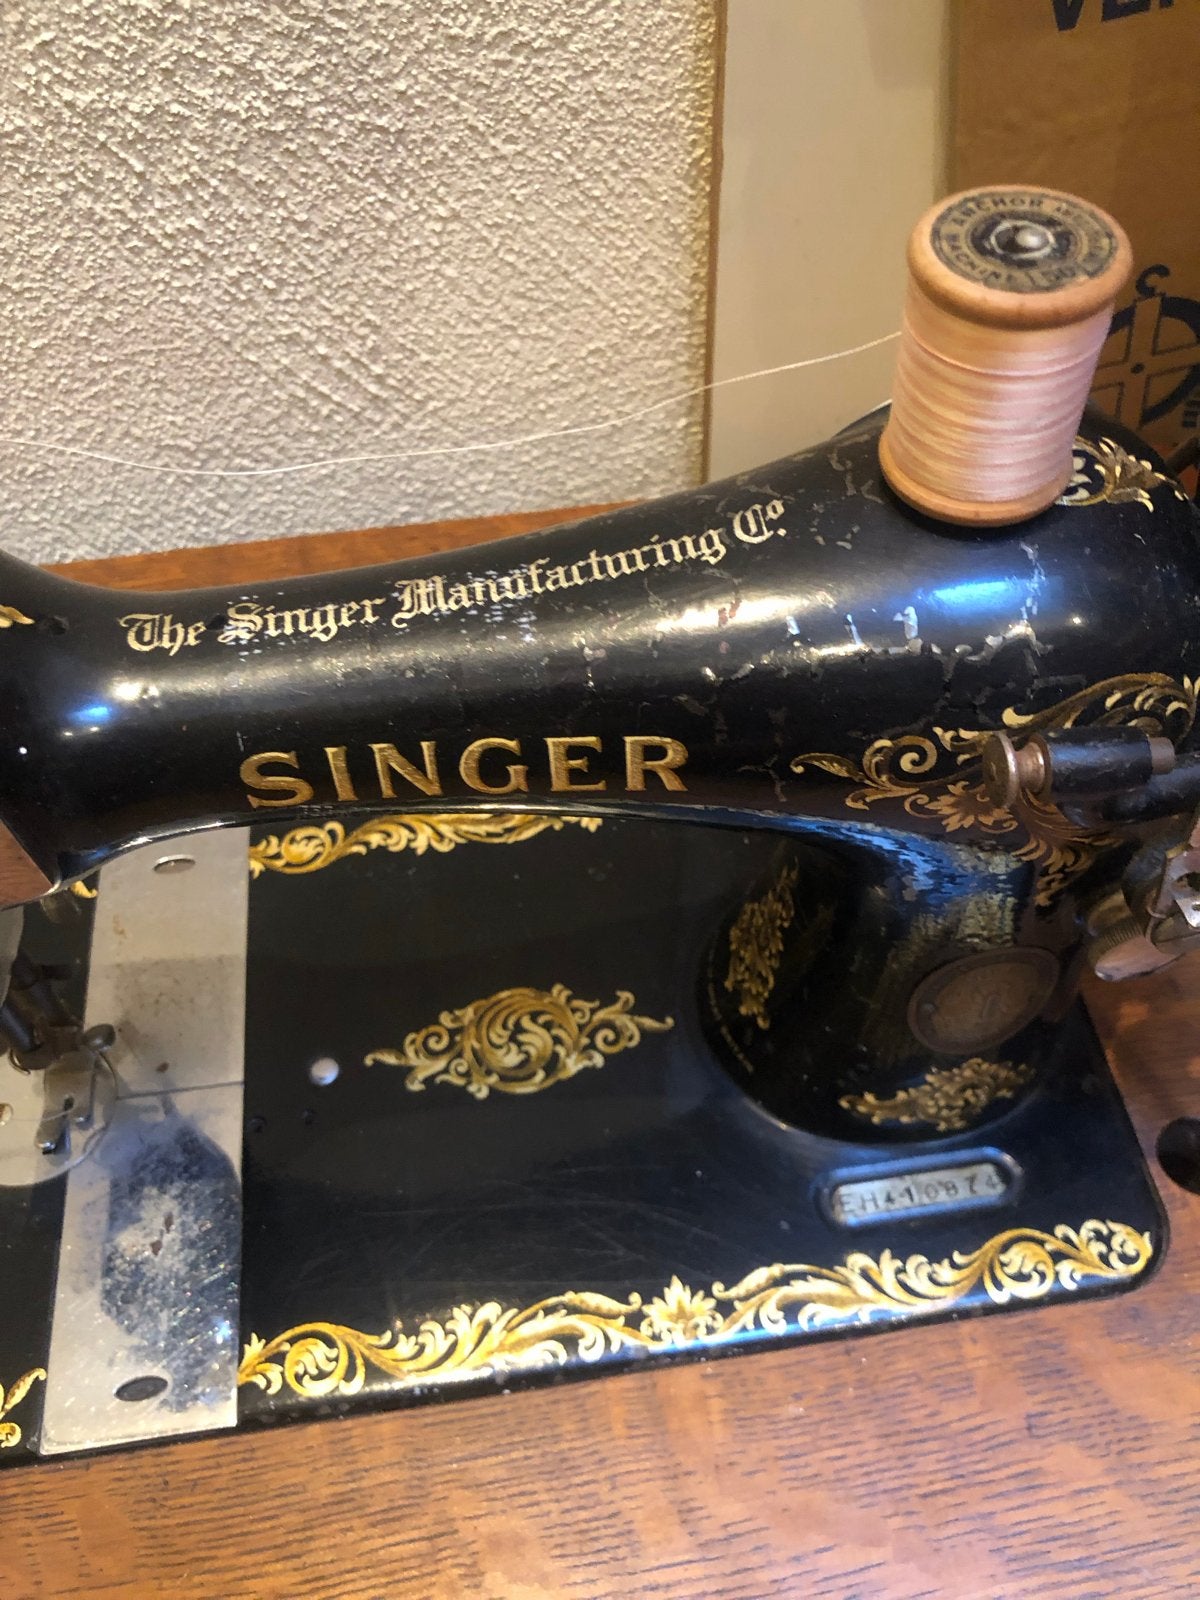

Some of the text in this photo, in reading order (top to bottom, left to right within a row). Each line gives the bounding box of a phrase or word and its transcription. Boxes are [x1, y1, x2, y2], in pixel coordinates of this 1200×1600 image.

[116, 612, 208, 656] The
[217, 595, 386, 643] Singer
[390, 527, 727, 629] Manufacturing
[239, 735, 690, 810] SINGER
